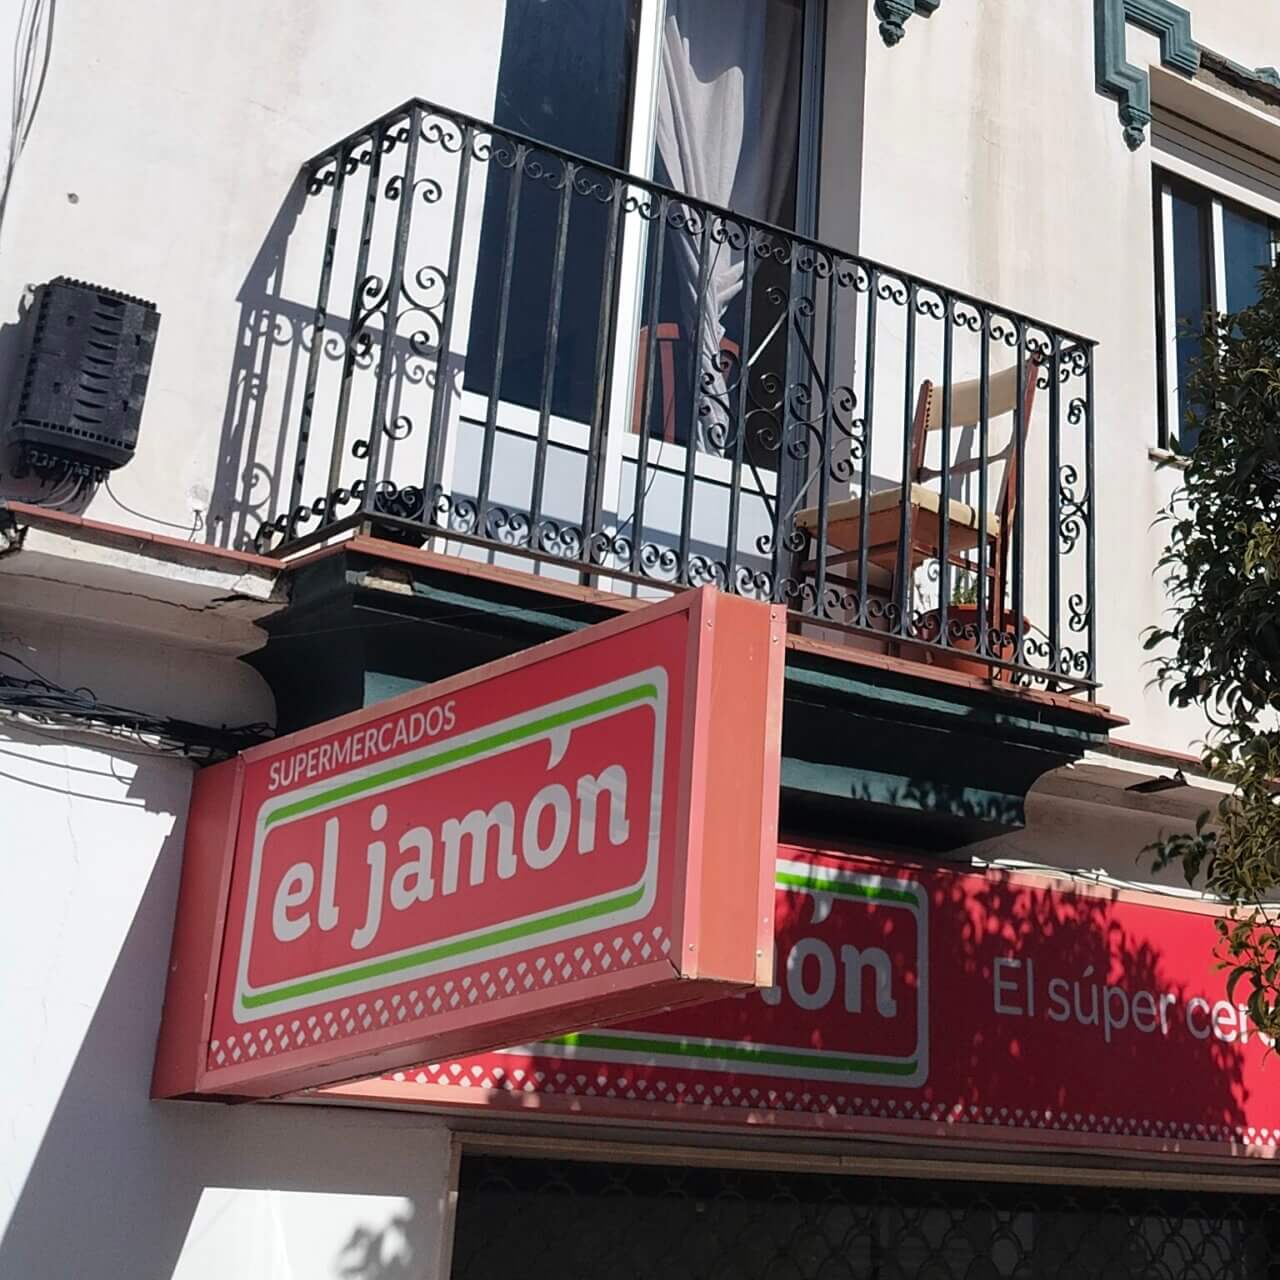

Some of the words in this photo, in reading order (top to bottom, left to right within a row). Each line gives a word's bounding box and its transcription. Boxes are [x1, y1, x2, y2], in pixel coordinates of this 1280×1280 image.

[268, 700, 456, 791] SUPERMERCADOS
[272, 816, 340, 942] el
[351, 728, 630, 949] jamón
[993, 957, 1034, 1017] El
[1048, 965, 1176, 1043] súper
[1186, 997, 1276, 1048] cer
